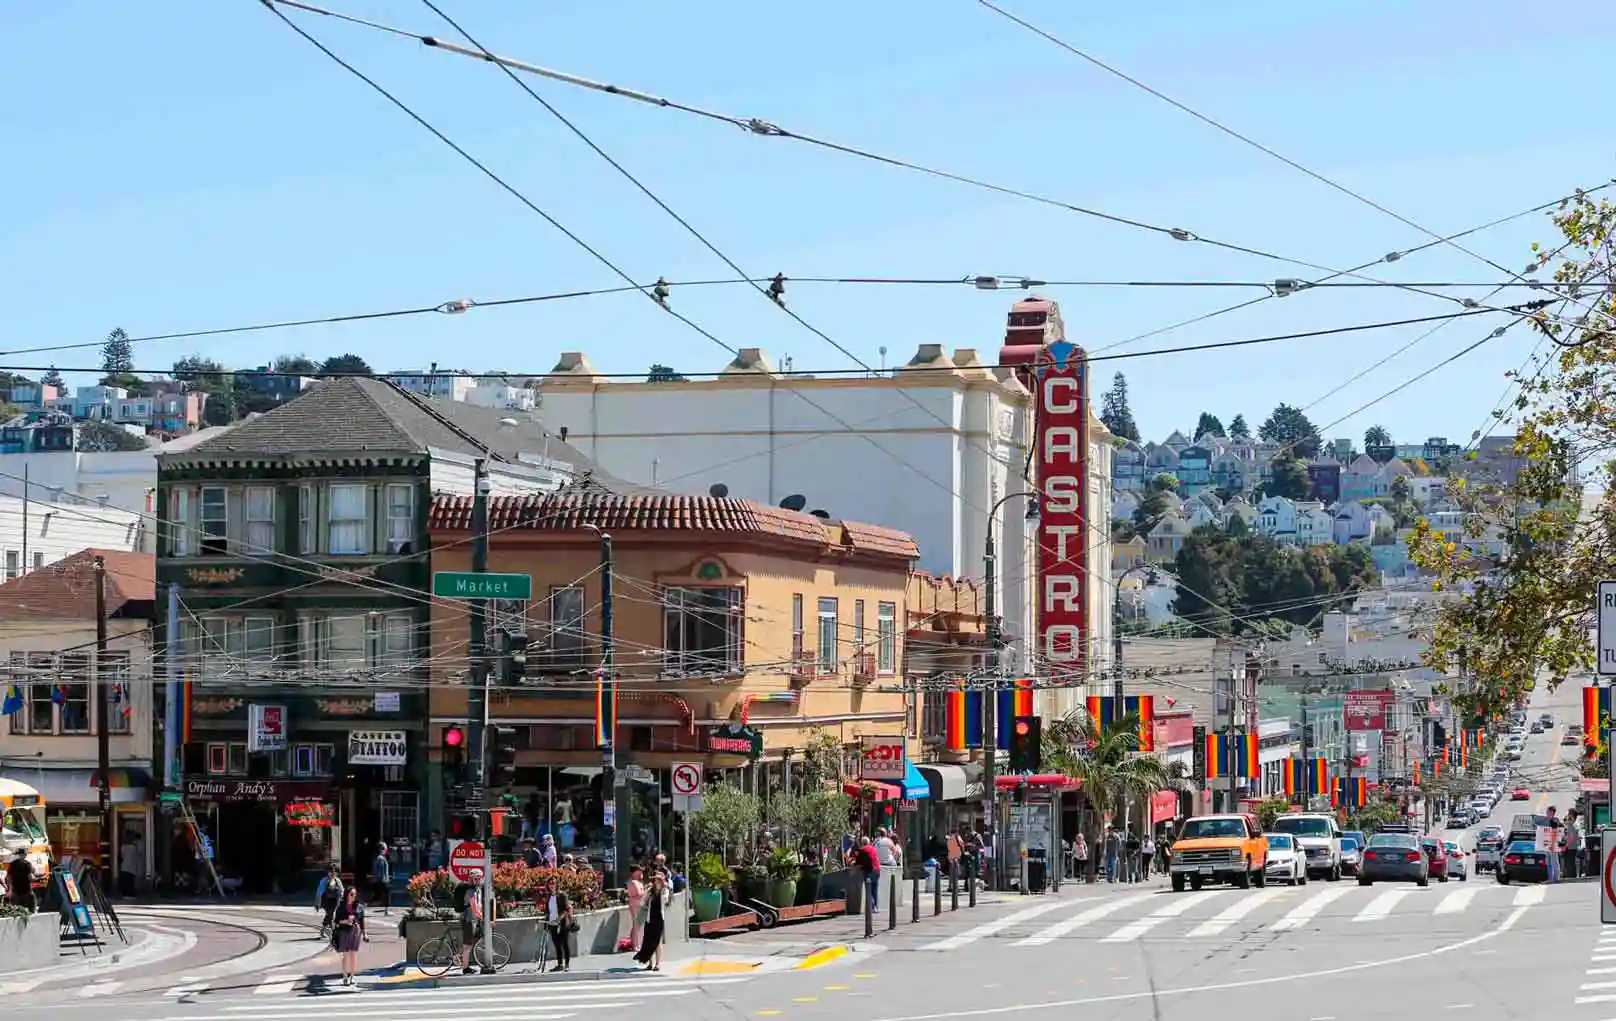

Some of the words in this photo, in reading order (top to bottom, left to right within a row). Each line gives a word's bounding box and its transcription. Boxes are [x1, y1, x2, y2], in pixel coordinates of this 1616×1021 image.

[1043, 376, 1080, 661] CASTRO
[456, 579, 509, 593] Market
[360, 741, 406, 757] TATTOO
[188, 780, 226, 798] Orphan
[233, 781, 276, 795] Andy's
